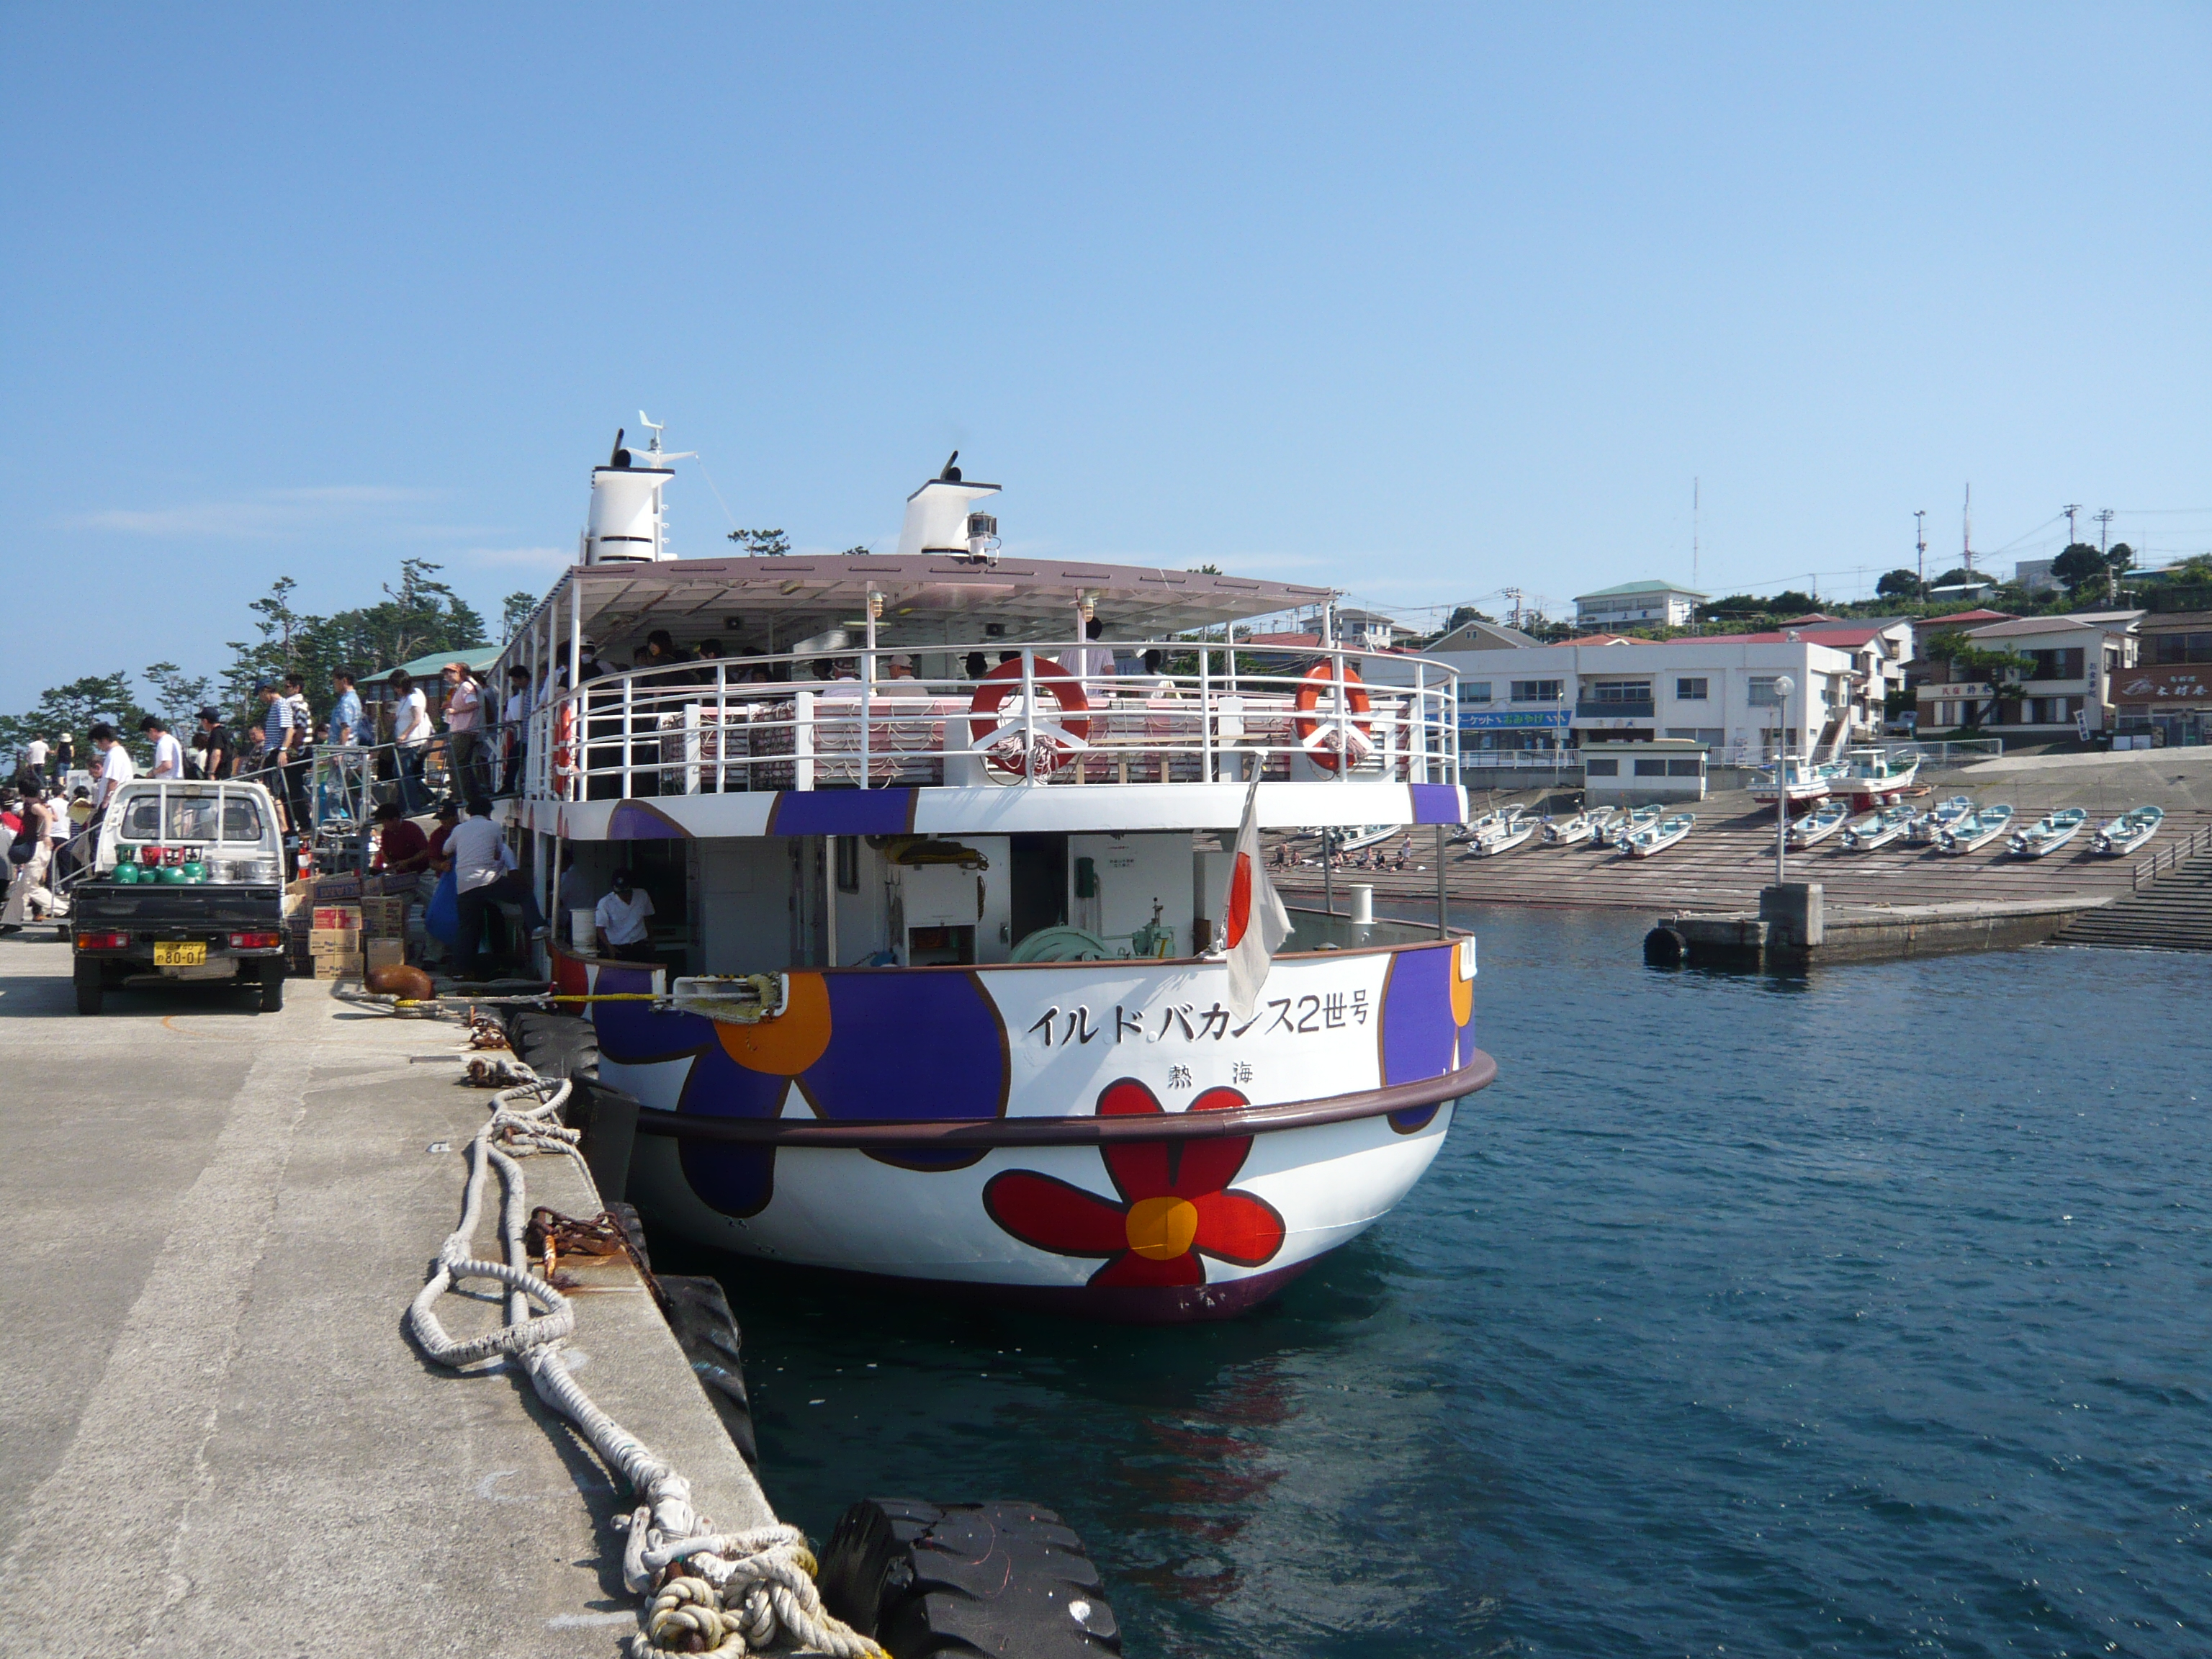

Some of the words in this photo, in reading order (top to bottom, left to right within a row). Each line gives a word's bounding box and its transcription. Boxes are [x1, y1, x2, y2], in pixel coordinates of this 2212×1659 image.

[1503, 714, 1545, 724] おみやげ
[1167, 1061, 1253, 1089] 熱海
